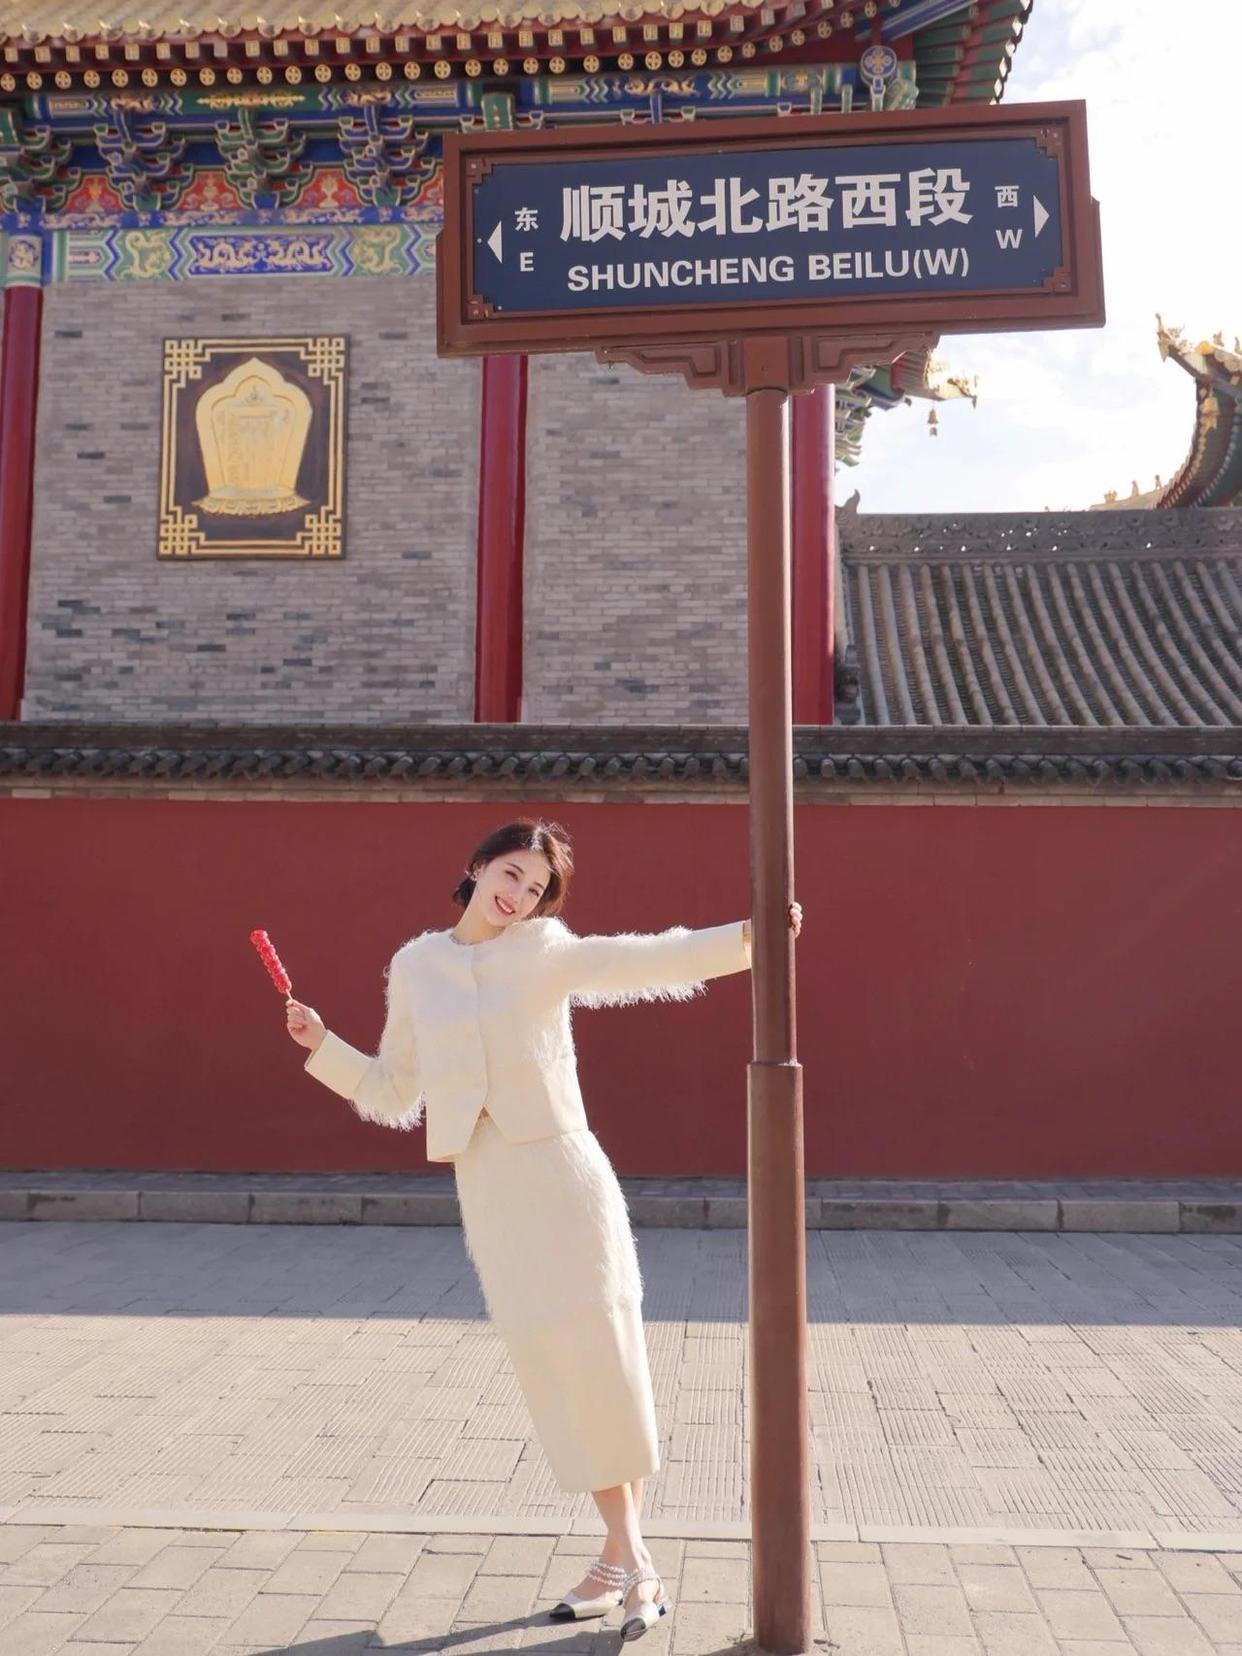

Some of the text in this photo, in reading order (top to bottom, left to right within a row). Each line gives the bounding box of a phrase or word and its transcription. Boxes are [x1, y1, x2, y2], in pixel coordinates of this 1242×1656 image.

[560, 168, 972, 242] 顺城北路西段
[995, 185, 1020, 208] 西
[514, 207, 539, 232] 东
[995, 229, 1023, 250] W
[519, 252, 534, 272] E
[568, 247, 970, 292] SHUNCHENG BEILU(W)
